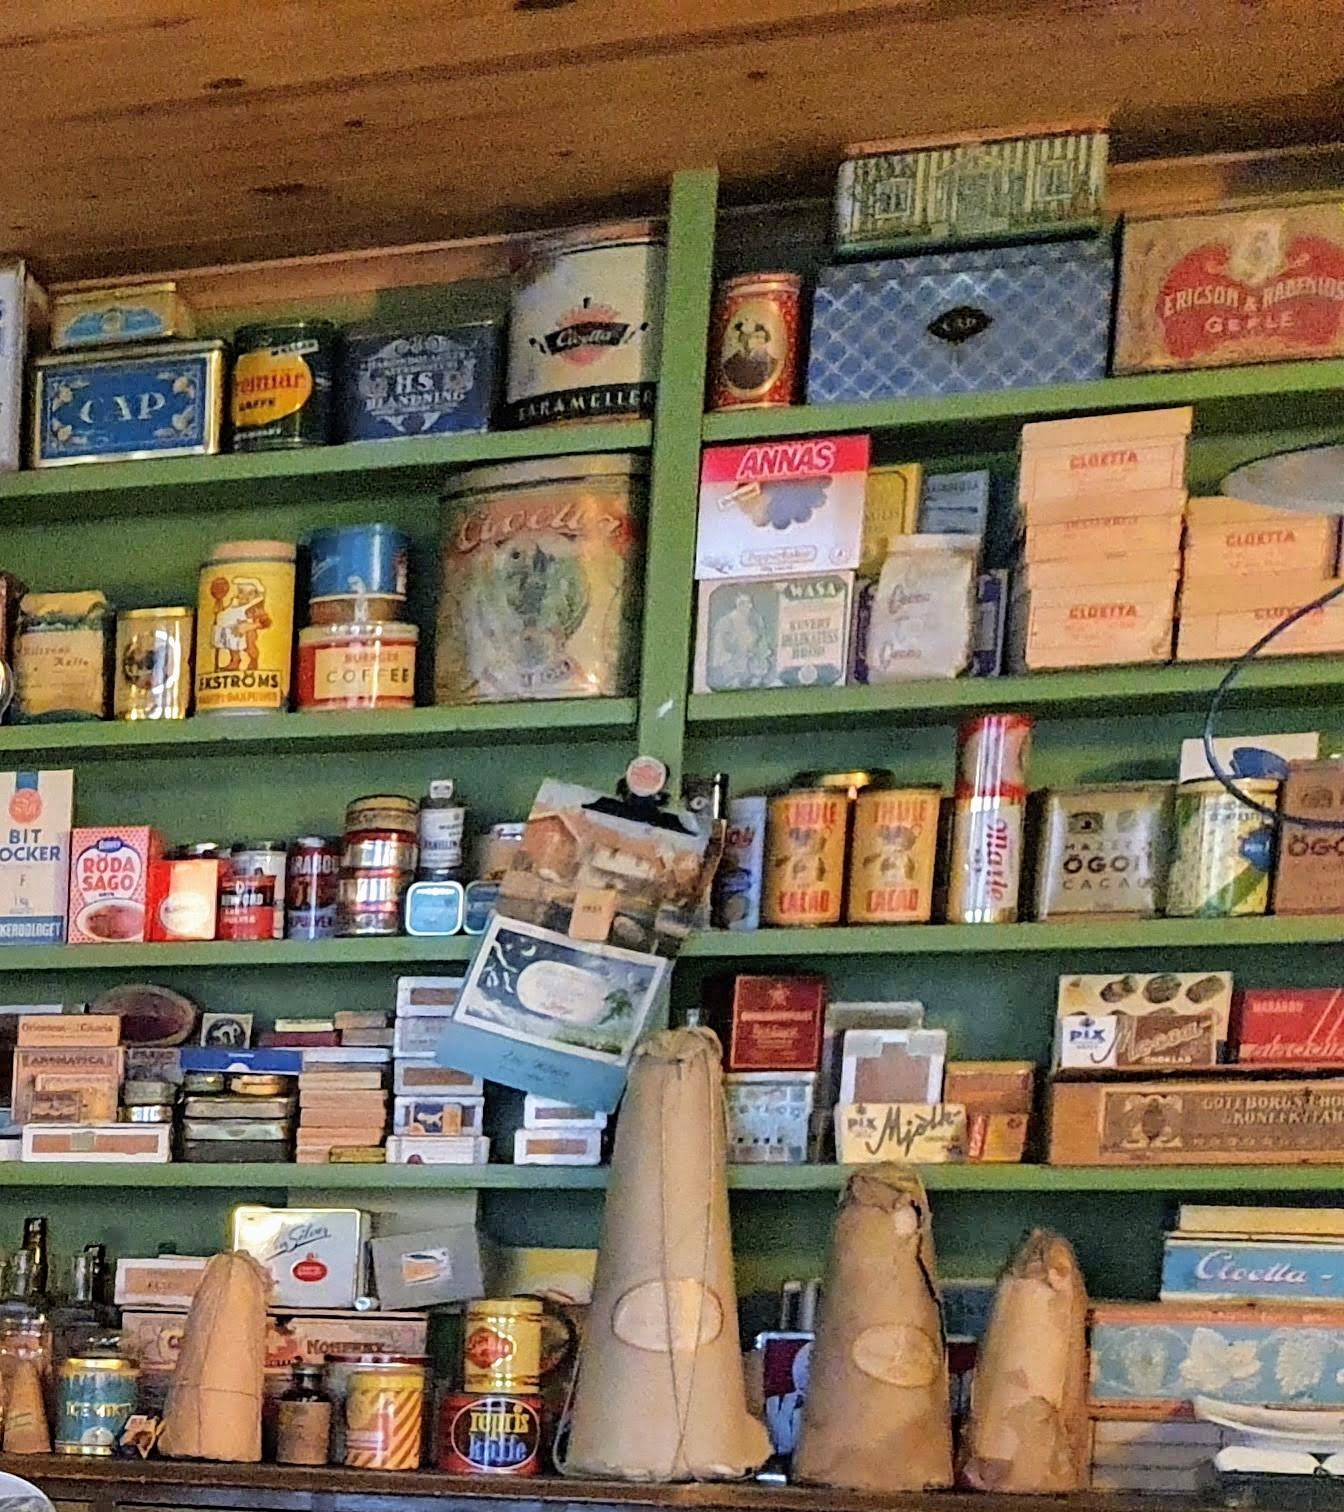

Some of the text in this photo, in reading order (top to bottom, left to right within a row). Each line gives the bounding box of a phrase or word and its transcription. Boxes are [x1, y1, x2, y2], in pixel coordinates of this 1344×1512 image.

[1163, 287, 1239, 317] ERICSON
[78, 393, 167, 425] CAP
[736, 441, 836, 480] ANNAS
[1069, 450, 1139, 471] CLOETTA
[1225, 529, 1296, 549] CLOETTA
[790, 582, 837, 598] WASA
[1068, 602, 1138, 621] CLOETTA
[198, 672, 279, 691] EKSTRÖMS
[326, 667, 410, 686] COFFEE
[8, 827, 43, 846] BIT
[83, 851, 136, 874] RÖDA
[292, 852, 340, 875] RABOU
[81, 874, 134, 893] SAGO
[1195, 1250, 1308, 1283] Cloetta
